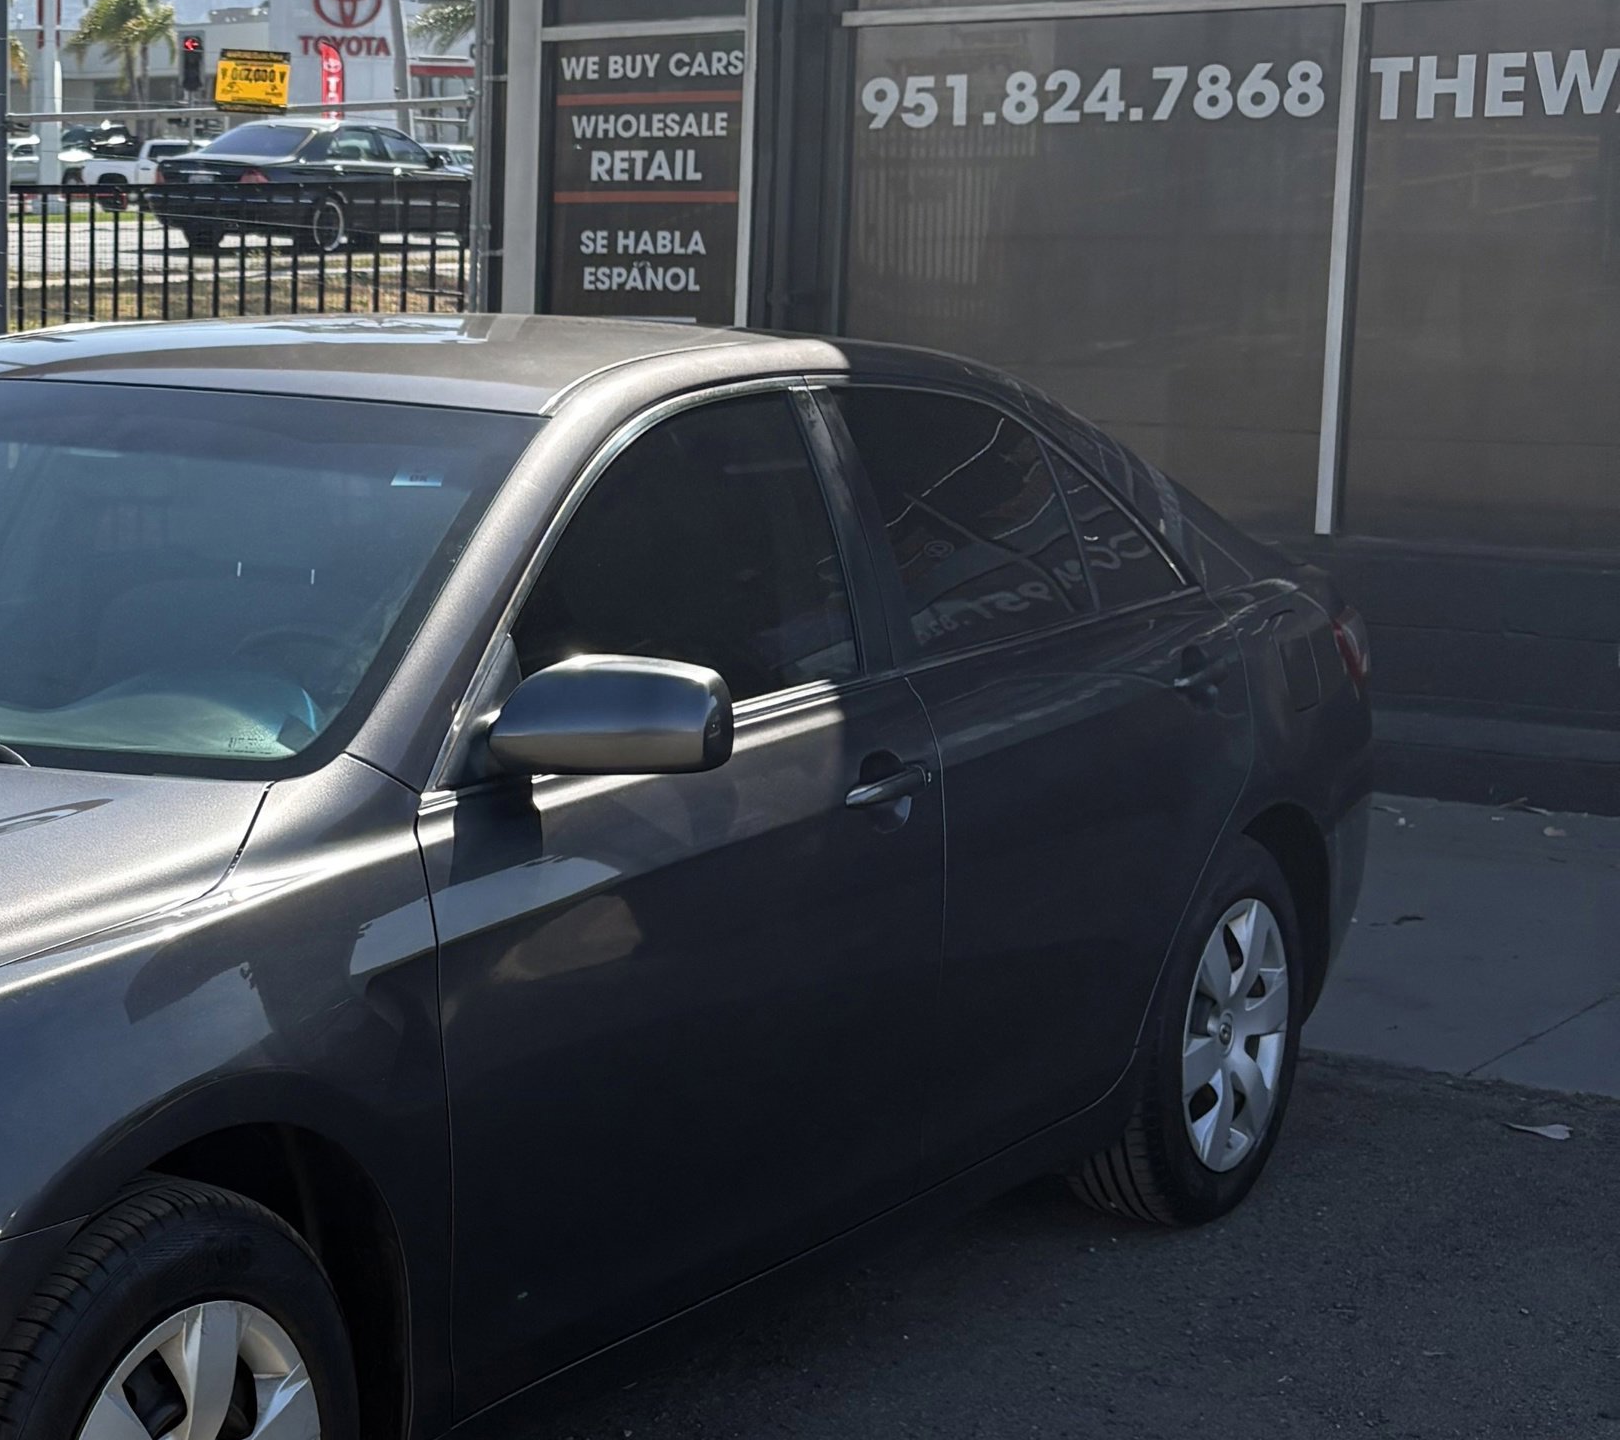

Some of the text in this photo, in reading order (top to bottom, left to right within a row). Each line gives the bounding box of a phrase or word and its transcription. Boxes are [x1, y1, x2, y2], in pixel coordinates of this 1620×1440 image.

[298, 35, 391, 57] TOYOTA
[561, 50, 744, 80] WE BUY CARS
[861, 60, 1326, 130] 951.824.7868
[1369, 47, 1620, 120] THEW
[571, 112, 728, 139] WHOLESALE
[590, 149, 703, 182] RETAIL
[580, 229, 707, 255] SE HABLA
[582, 260, 701, 292] ESPAÑOL
